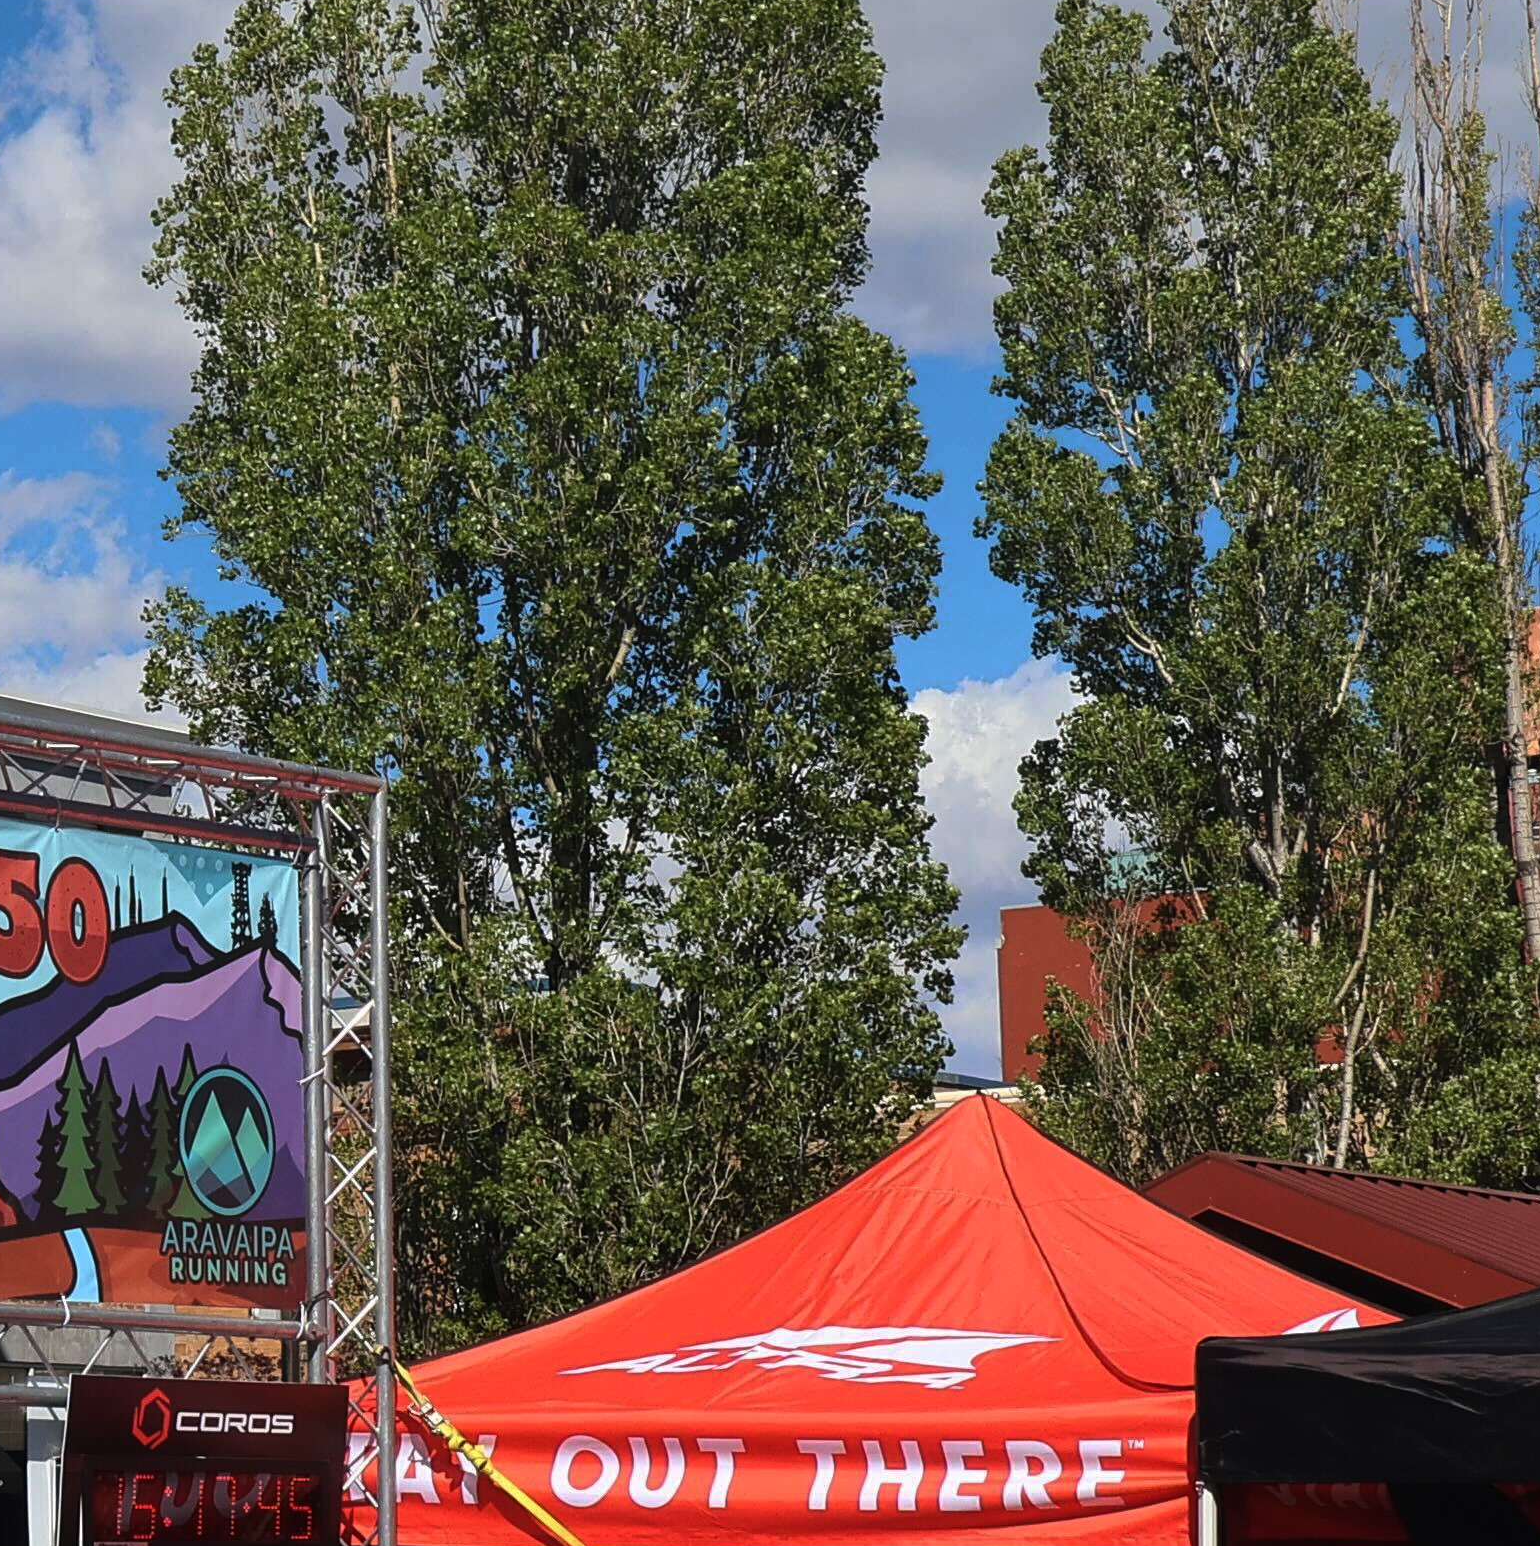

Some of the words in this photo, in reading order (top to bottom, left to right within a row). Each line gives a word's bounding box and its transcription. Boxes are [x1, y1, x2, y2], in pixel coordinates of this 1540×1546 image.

[162, 1221, 294, 1260] ARAVAIPA
[171, 1256, 287, 1286] RUNNING
[175, 1411, 294, 1434] COROS
[346, 1432, 497, 1505] TAY
[550, 1434, 746, 1509] OUT
